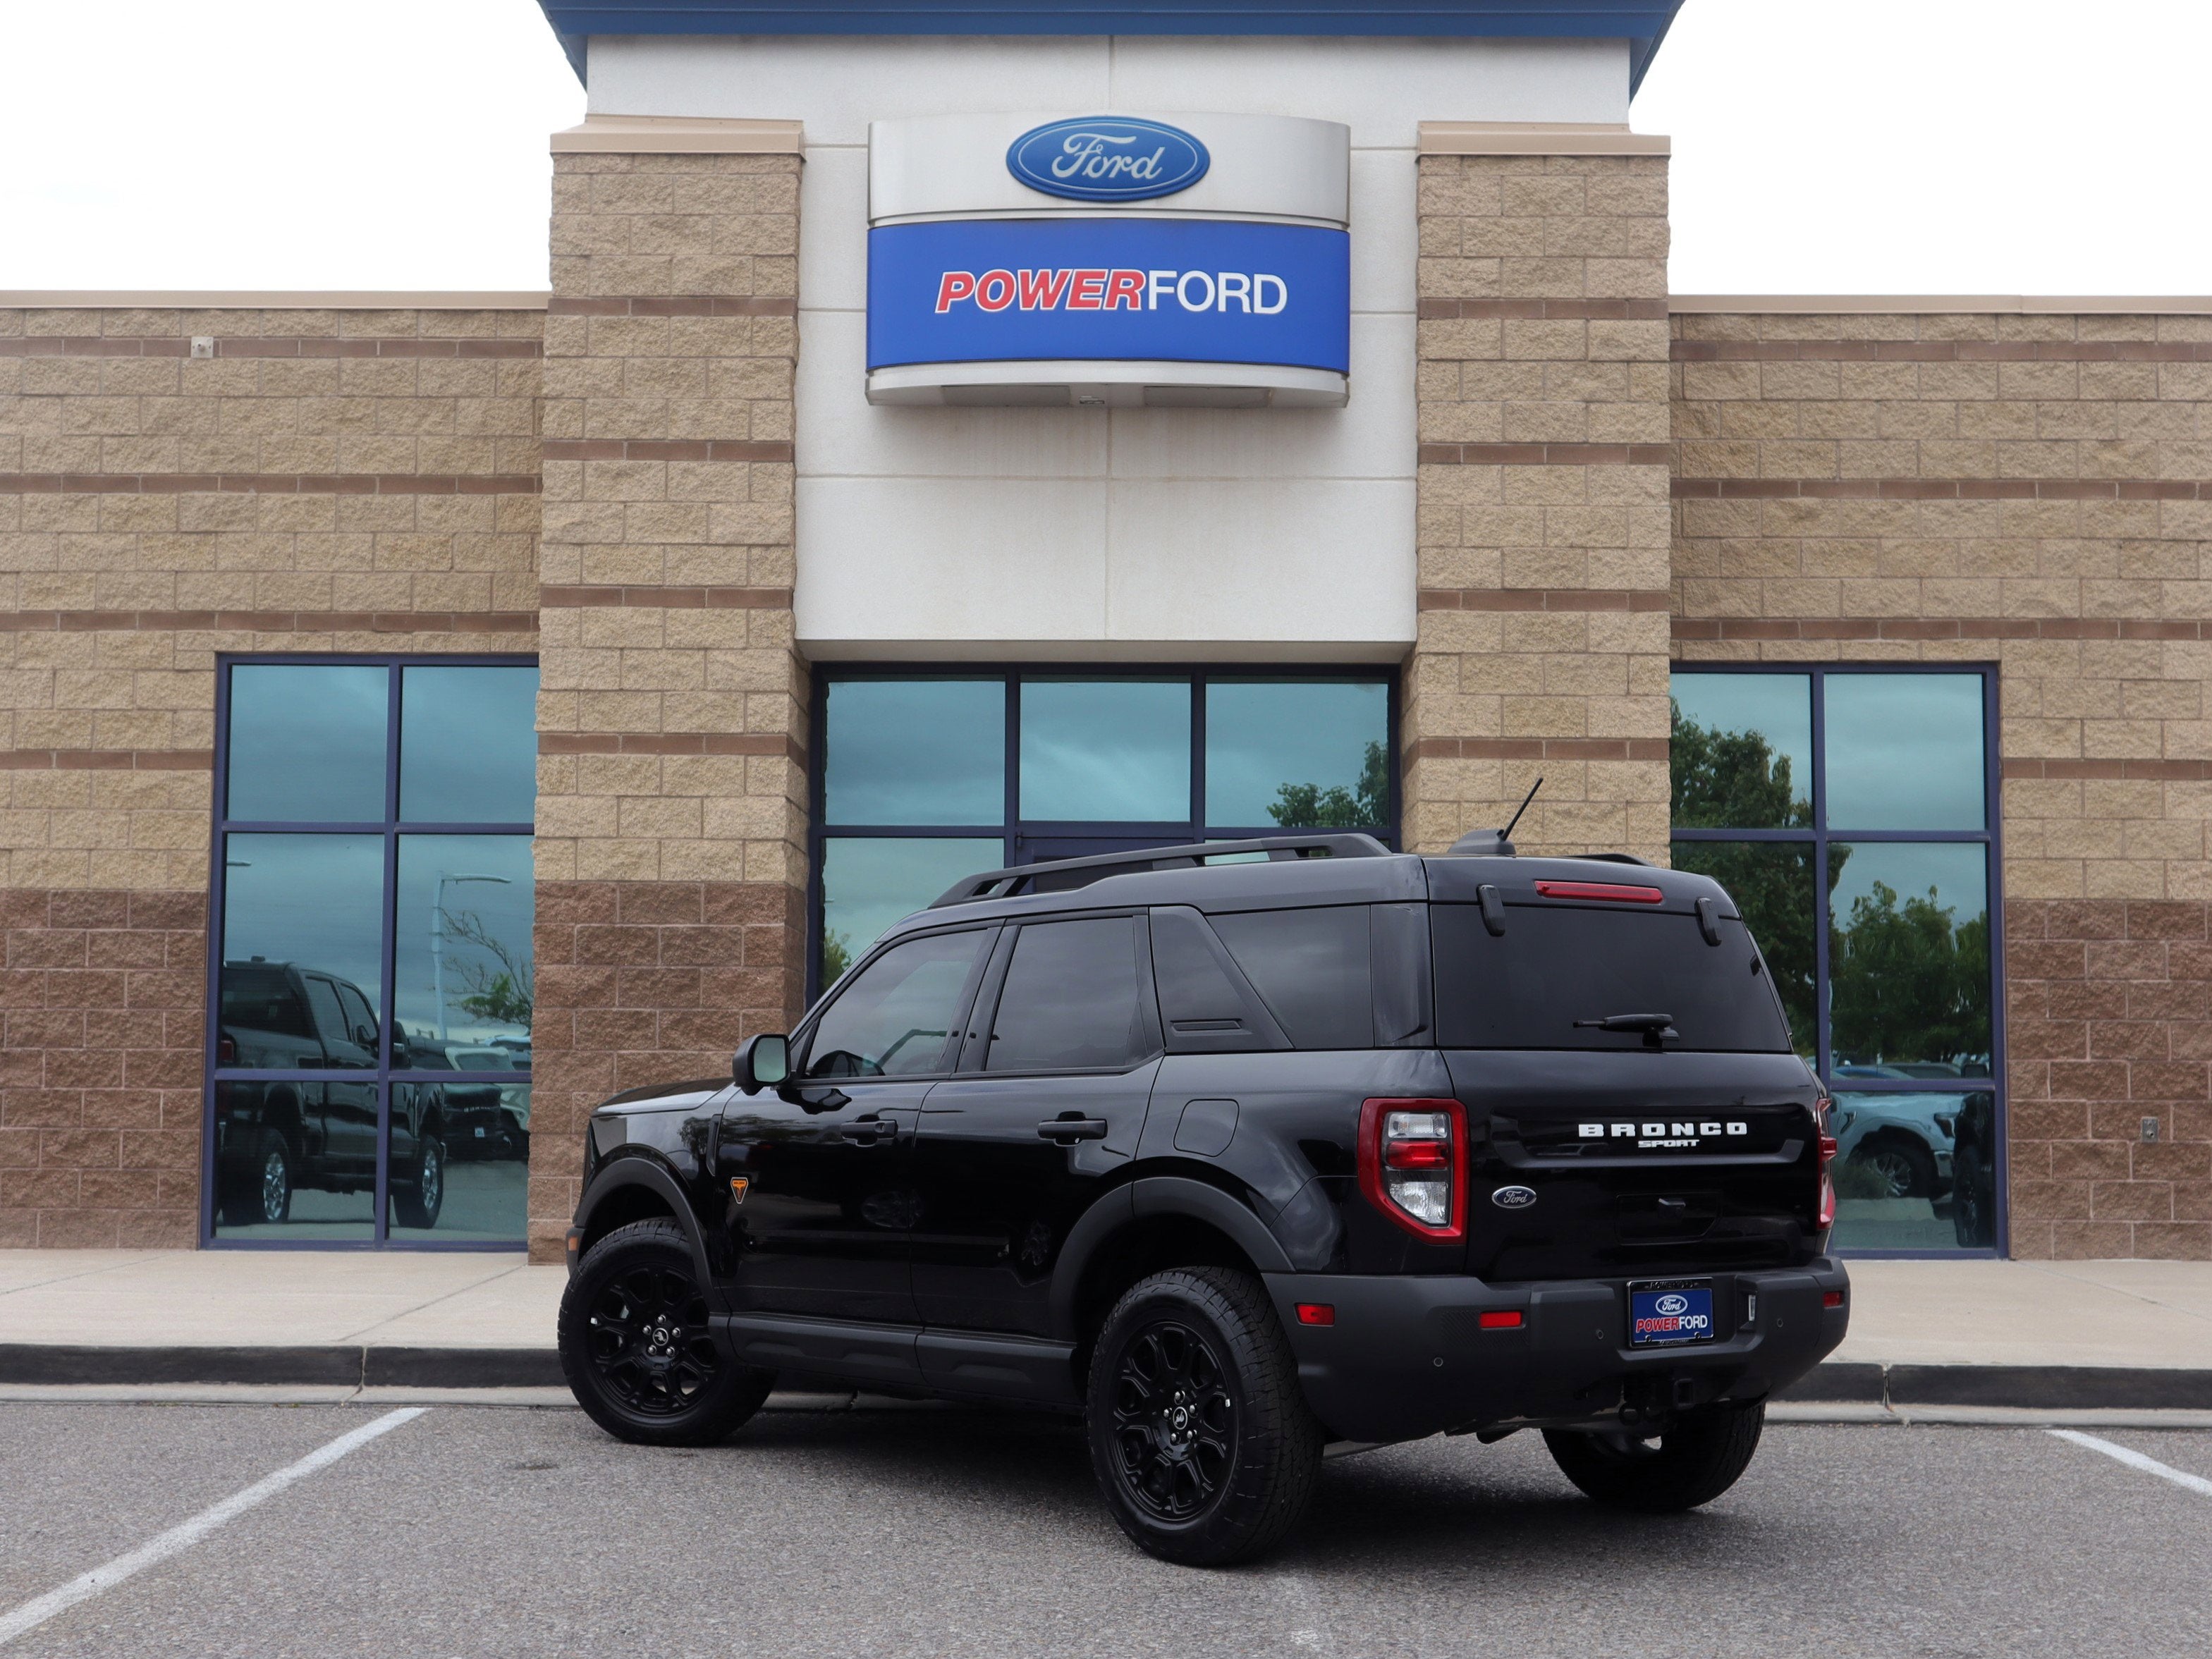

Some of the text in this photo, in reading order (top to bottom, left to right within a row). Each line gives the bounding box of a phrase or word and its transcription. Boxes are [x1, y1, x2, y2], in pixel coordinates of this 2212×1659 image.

[1051, 133, 1164, 180] Ford
[934, 269, 1288, 314] POWERFORD
[1578, 1122, 1748, 1137] BRONCO
[1638, 1139, 1699, 1148] SPORT
[1503, 1190, 1527, 1204] Ford
[1662, 1299, 1681, 1311] Ford
[1636, 1315, 1708, 1333] POWERFORD
